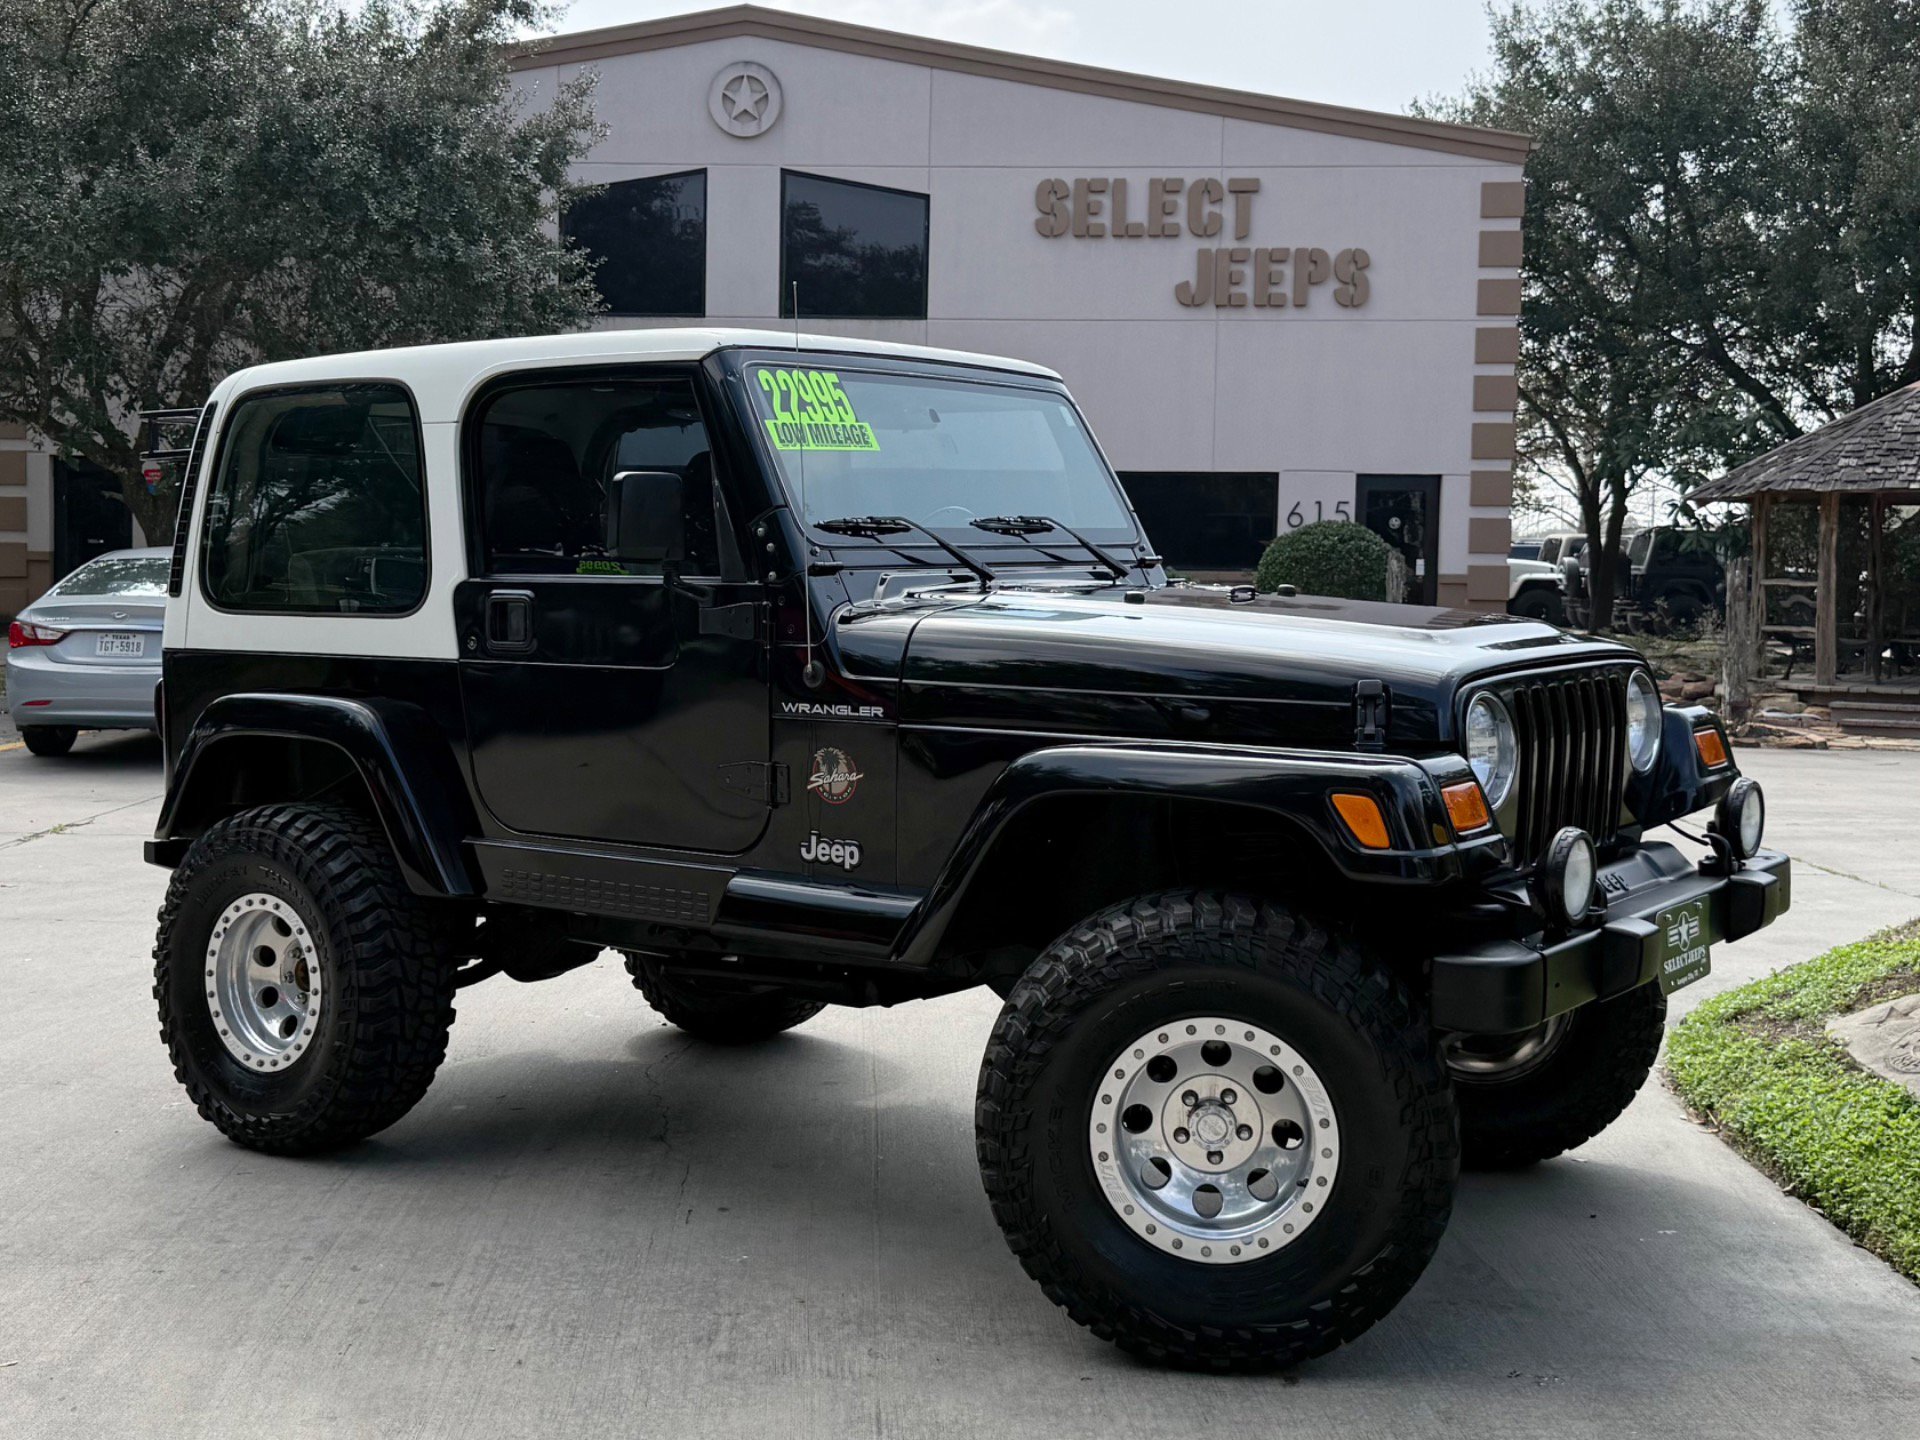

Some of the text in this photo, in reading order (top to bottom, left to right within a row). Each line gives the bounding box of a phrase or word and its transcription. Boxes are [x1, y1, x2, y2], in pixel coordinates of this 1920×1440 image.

[1035, 178, 1260, 240] SELECT
[1175, 248, 1370, 307] JEEPS
[757, 369, 857, 423] 22995
[773, 422, 871, 445] LOW MILEAGE
[1287, 501, 1350, 528] 615
[99, 641, 141, 653] TGT-5918
[781, 702, 884, 717] WRANGLER
[807, 768, 864, 789] Sahara
[800, 830, 861, 870] Jeep
